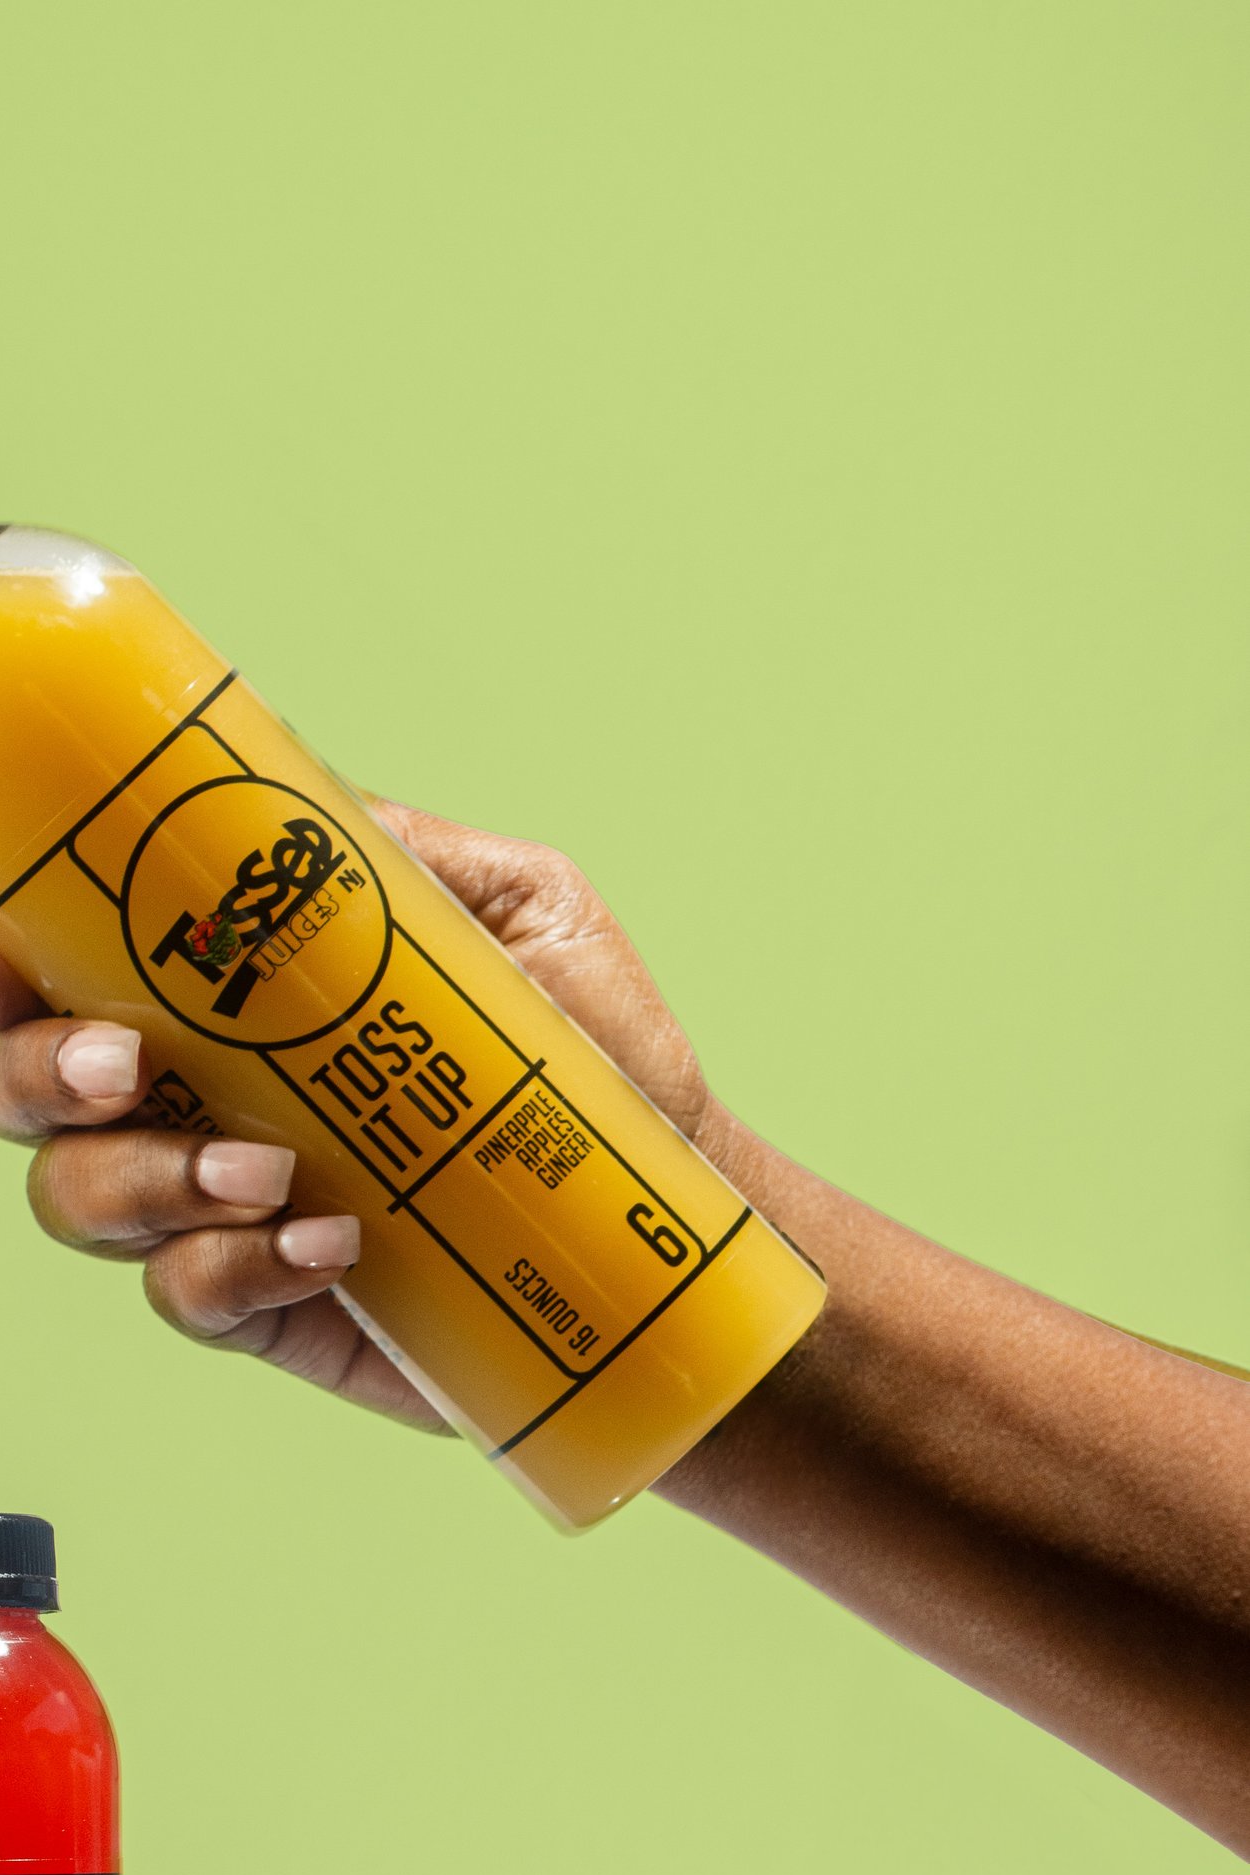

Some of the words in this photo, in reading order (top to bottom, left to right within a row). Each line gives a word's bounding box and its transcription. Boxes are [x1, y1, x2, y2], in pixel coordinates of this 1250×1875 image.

[336, 868, 366, 893] NJ
[247, 888, 340, 981] JUICES
[309, 1000, 434, 1120] TOSS
[359, 1104, 423, 1173] IT
[401, 1051, 474, 1131] UP
[473, 1089, 556, 1173] PINEAPPLE
[515, 1110, 575, 1172] APPLES
[536, 1131, 595, 1190] GINGER
[626, 1202, 688, 1268] 6
[504, 1258, 579, 1334] OUNCES
[569, 1316, 601, 1357] 16
